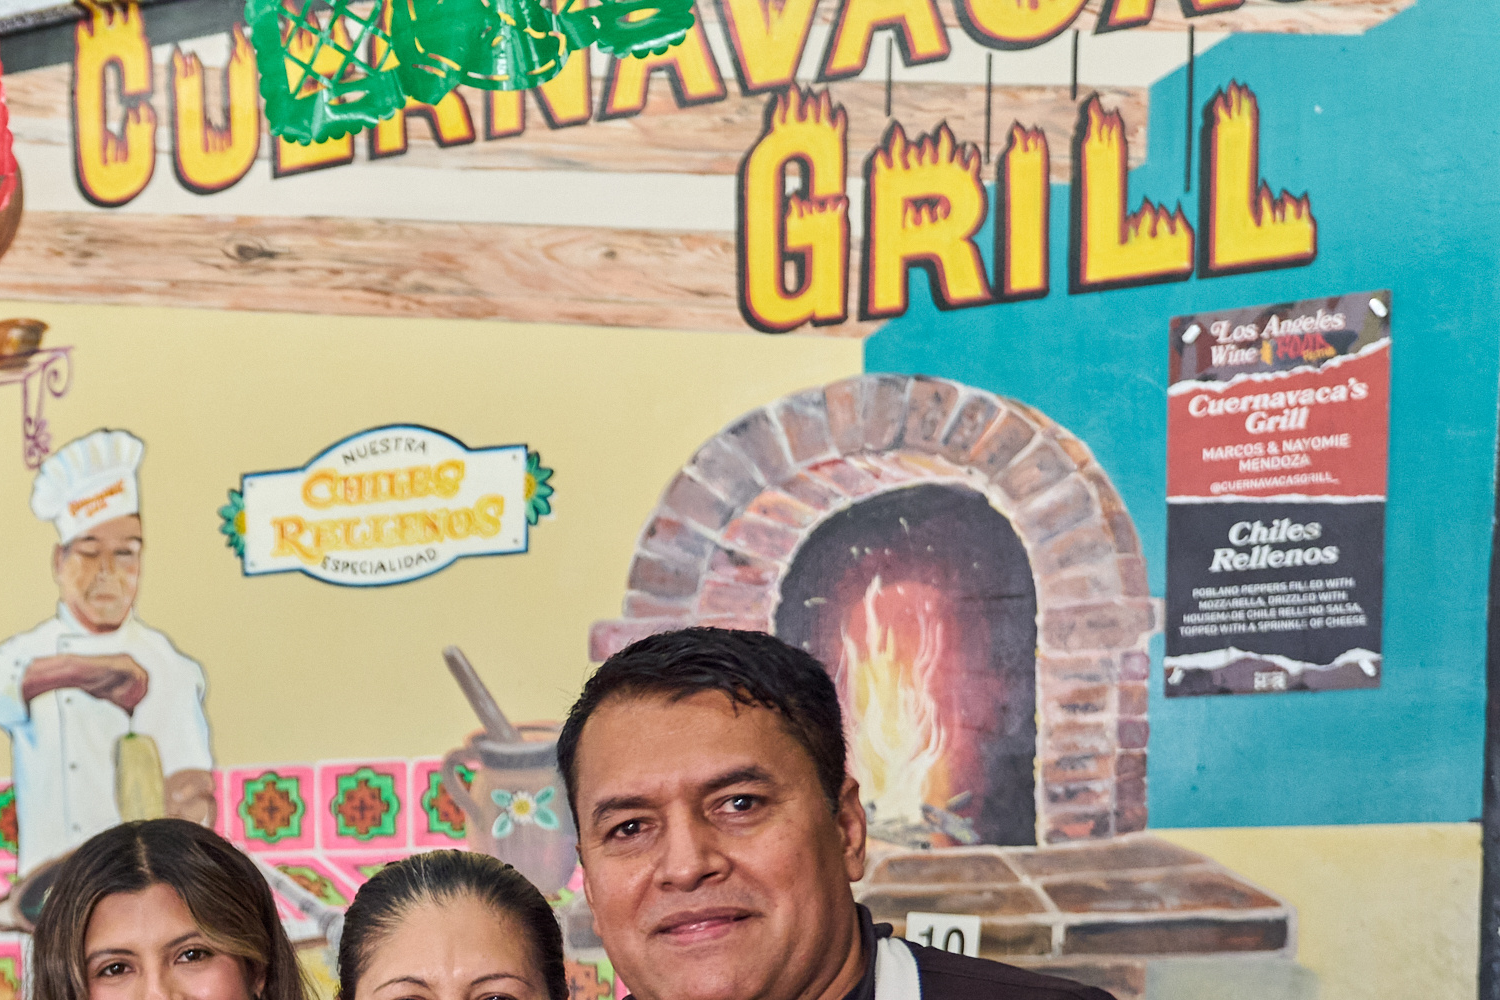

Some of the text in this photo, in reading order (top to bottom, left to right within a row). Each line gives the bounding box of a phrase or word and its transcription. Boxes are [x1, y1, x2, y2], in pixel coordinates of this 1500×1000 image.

[737, 78, 1317, 332] GRILL
[1210, 308, 1347, 344] Los Angeles
[1210, 344, 1260, 368] Wine
[1244, 408, 1311, 435] Grill
[341, 437, 427, 464] NUESTRA
[1202, 433, 1351, 461] MARCOS & NAYOMIE
[1238, 454, 1312, 473] MENDOZA
[301, 459, 466, 510] CHILES
[271, 493, 506, 565] RELLENOS
[1228, 518, 1322, 546] Chiles
[322, 549, 437, 575] ESPECIALIDAD
[1208, 545, 1340, 573] Rellenos
[1192, 585, 1239, 599] POBLANO
[1240, 582, 1287, 595] PEPPERS
[1325, 577, 1356, 588] WITH
[1318, 590, 1349, 602] WITH
[1179, 625, 1218, 637] TOPPED
[1219, 622, 1246, 635] WITH
[1309, 617, 1324, 629] OF
[1325, 614, 1367, 627] CHEESE
[1246, 607, 1277, 621] CHILE
[1278, 604, 1323, 617] RELLENO
